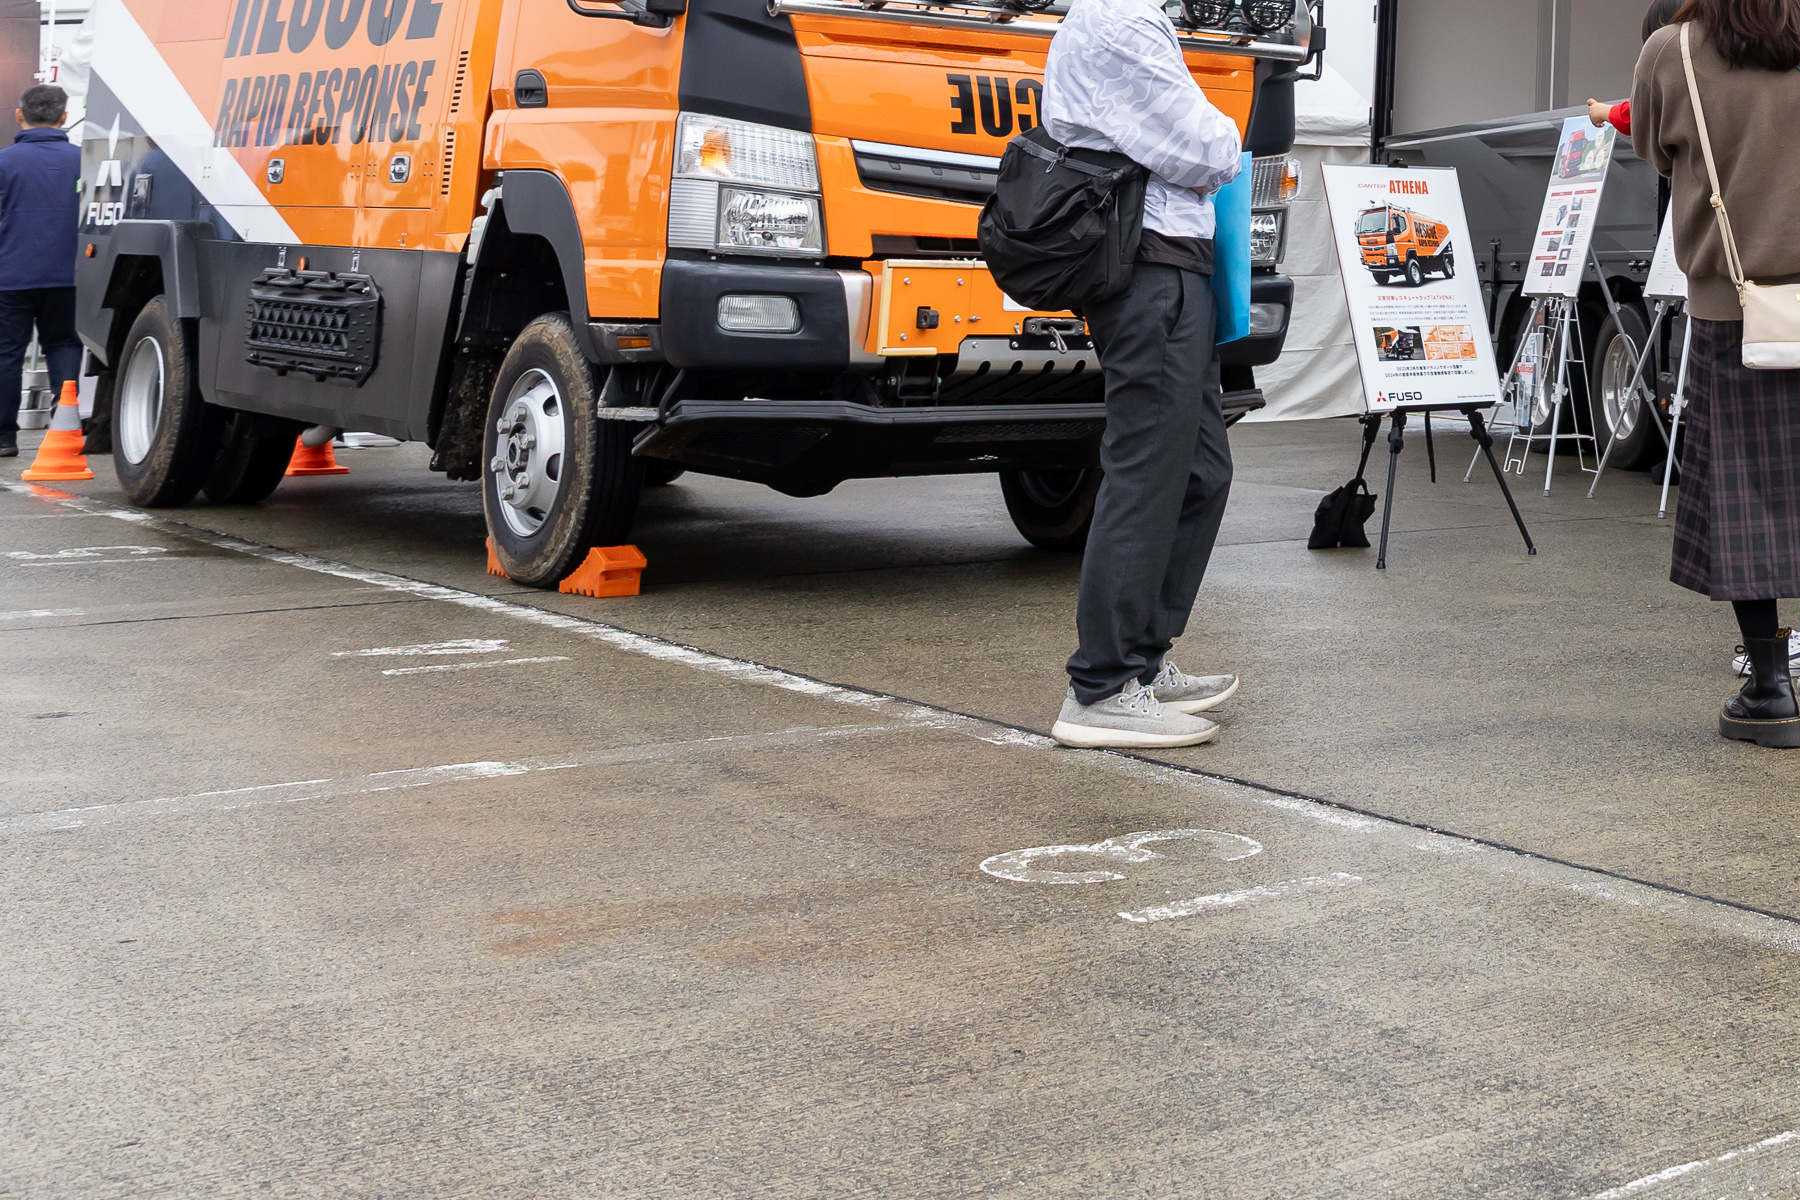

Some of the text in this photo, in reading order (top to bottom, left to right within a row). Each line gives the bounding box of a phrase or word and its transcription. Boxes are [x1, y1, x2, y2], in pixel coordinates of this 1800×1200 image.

[212, 60, 437, 149] RAPID RESPONSE
[1389, 180, 1429, 195] ATHENA
[86, 201, 124, 226] FUSO
[1388, 391, 1423, 402] FUSO
